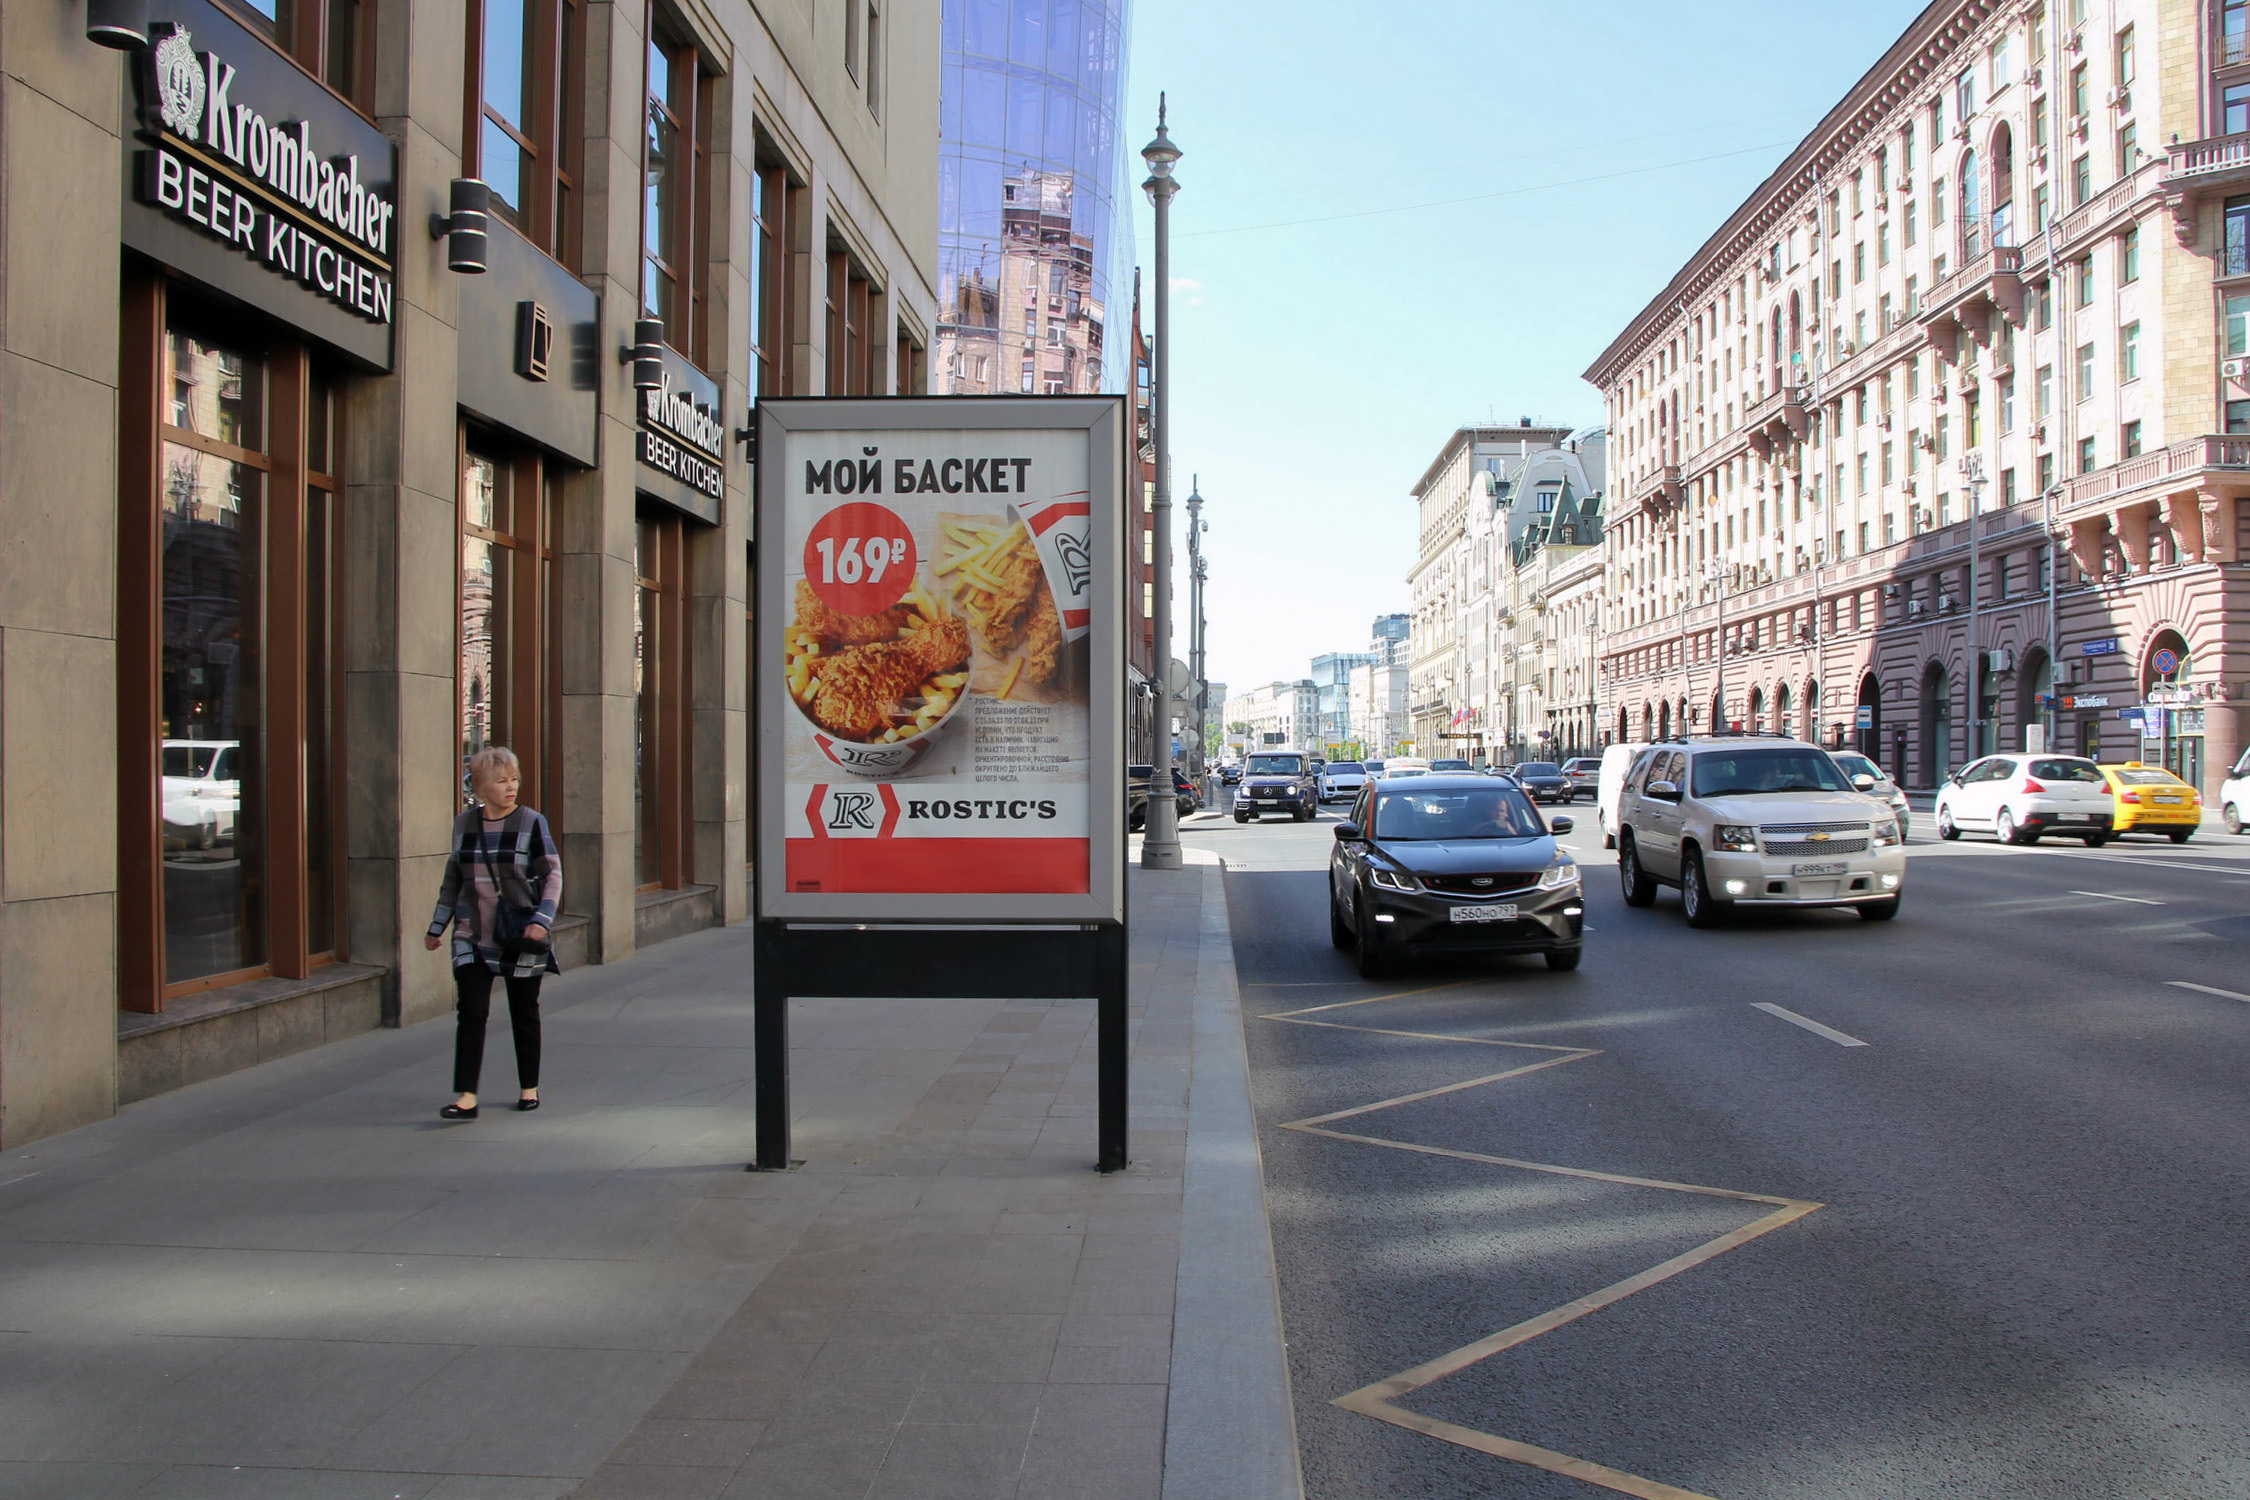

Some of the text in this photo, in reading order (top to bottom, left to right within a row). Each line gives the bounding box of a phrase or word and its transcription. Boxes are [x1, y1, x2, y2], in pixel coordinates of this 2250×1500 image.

[208, 50, 393, 255] Krombacher
[158, 149, 392, 324] BEER KITCHEN
[661, 370, 723, 458] Krombacher
[646, 431, 723, 499] BEER KITCHEN
[805, 446, 1032, 494] МОЙ БАСКЕТ
[975, 705, 1051, 715] ПРЕДЛОЖЕНИЕ ДЕЙСТВУЕТ
[2074, 694, 2108, 707] Экспобанк
[975, 775, 997, 783] ЦЕЛОГО
[908, 800, 1057, 819] ROSTIC'S
